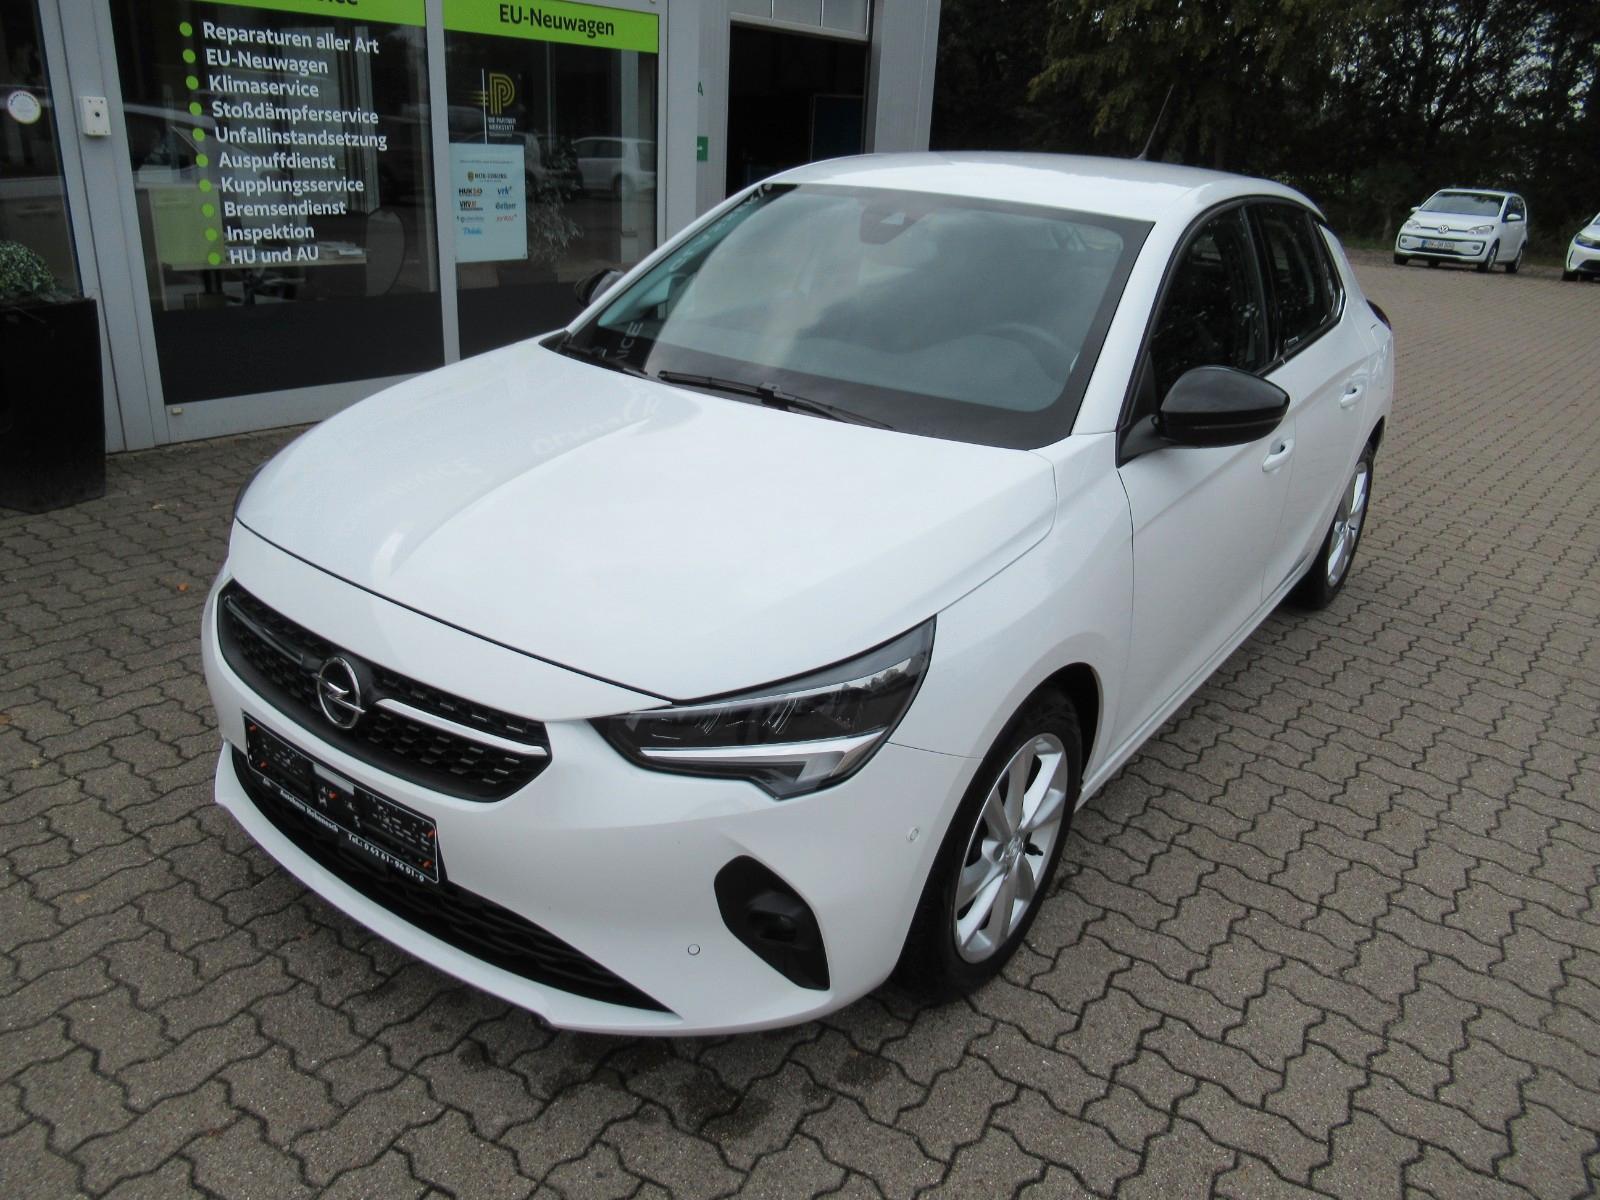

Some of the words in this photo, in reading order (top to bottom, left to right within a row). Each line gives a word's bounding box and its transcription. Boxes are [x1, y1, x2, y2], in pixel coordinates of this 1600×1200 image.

[499, 3, 615, 39] EU-Neuwagen
[202, 21, 312, 48] Reparaturen
[316, 32, 350, 52] aller
[354, 37, 380, 54] Art
[206, 48, 328, 77] EU-Neuwagen
[209, 74, 319, 98] Klimaservice
[211, 100, 379, 125] Stoßdämpferservice
[215, 126, 387, 151] Unfallinstandsetzung
[219, 151, 336, 172] Auspuffdienst
[221, 176, 364, 196] Kupplungsservice
[224, 200, 347, 217] Bremsendienst
[226, 224, 315, 244] Inspektion
[229, 248, 257, 265] HU
[261, 247, 292, 263] und
[296, 246, 320, 262] AU
